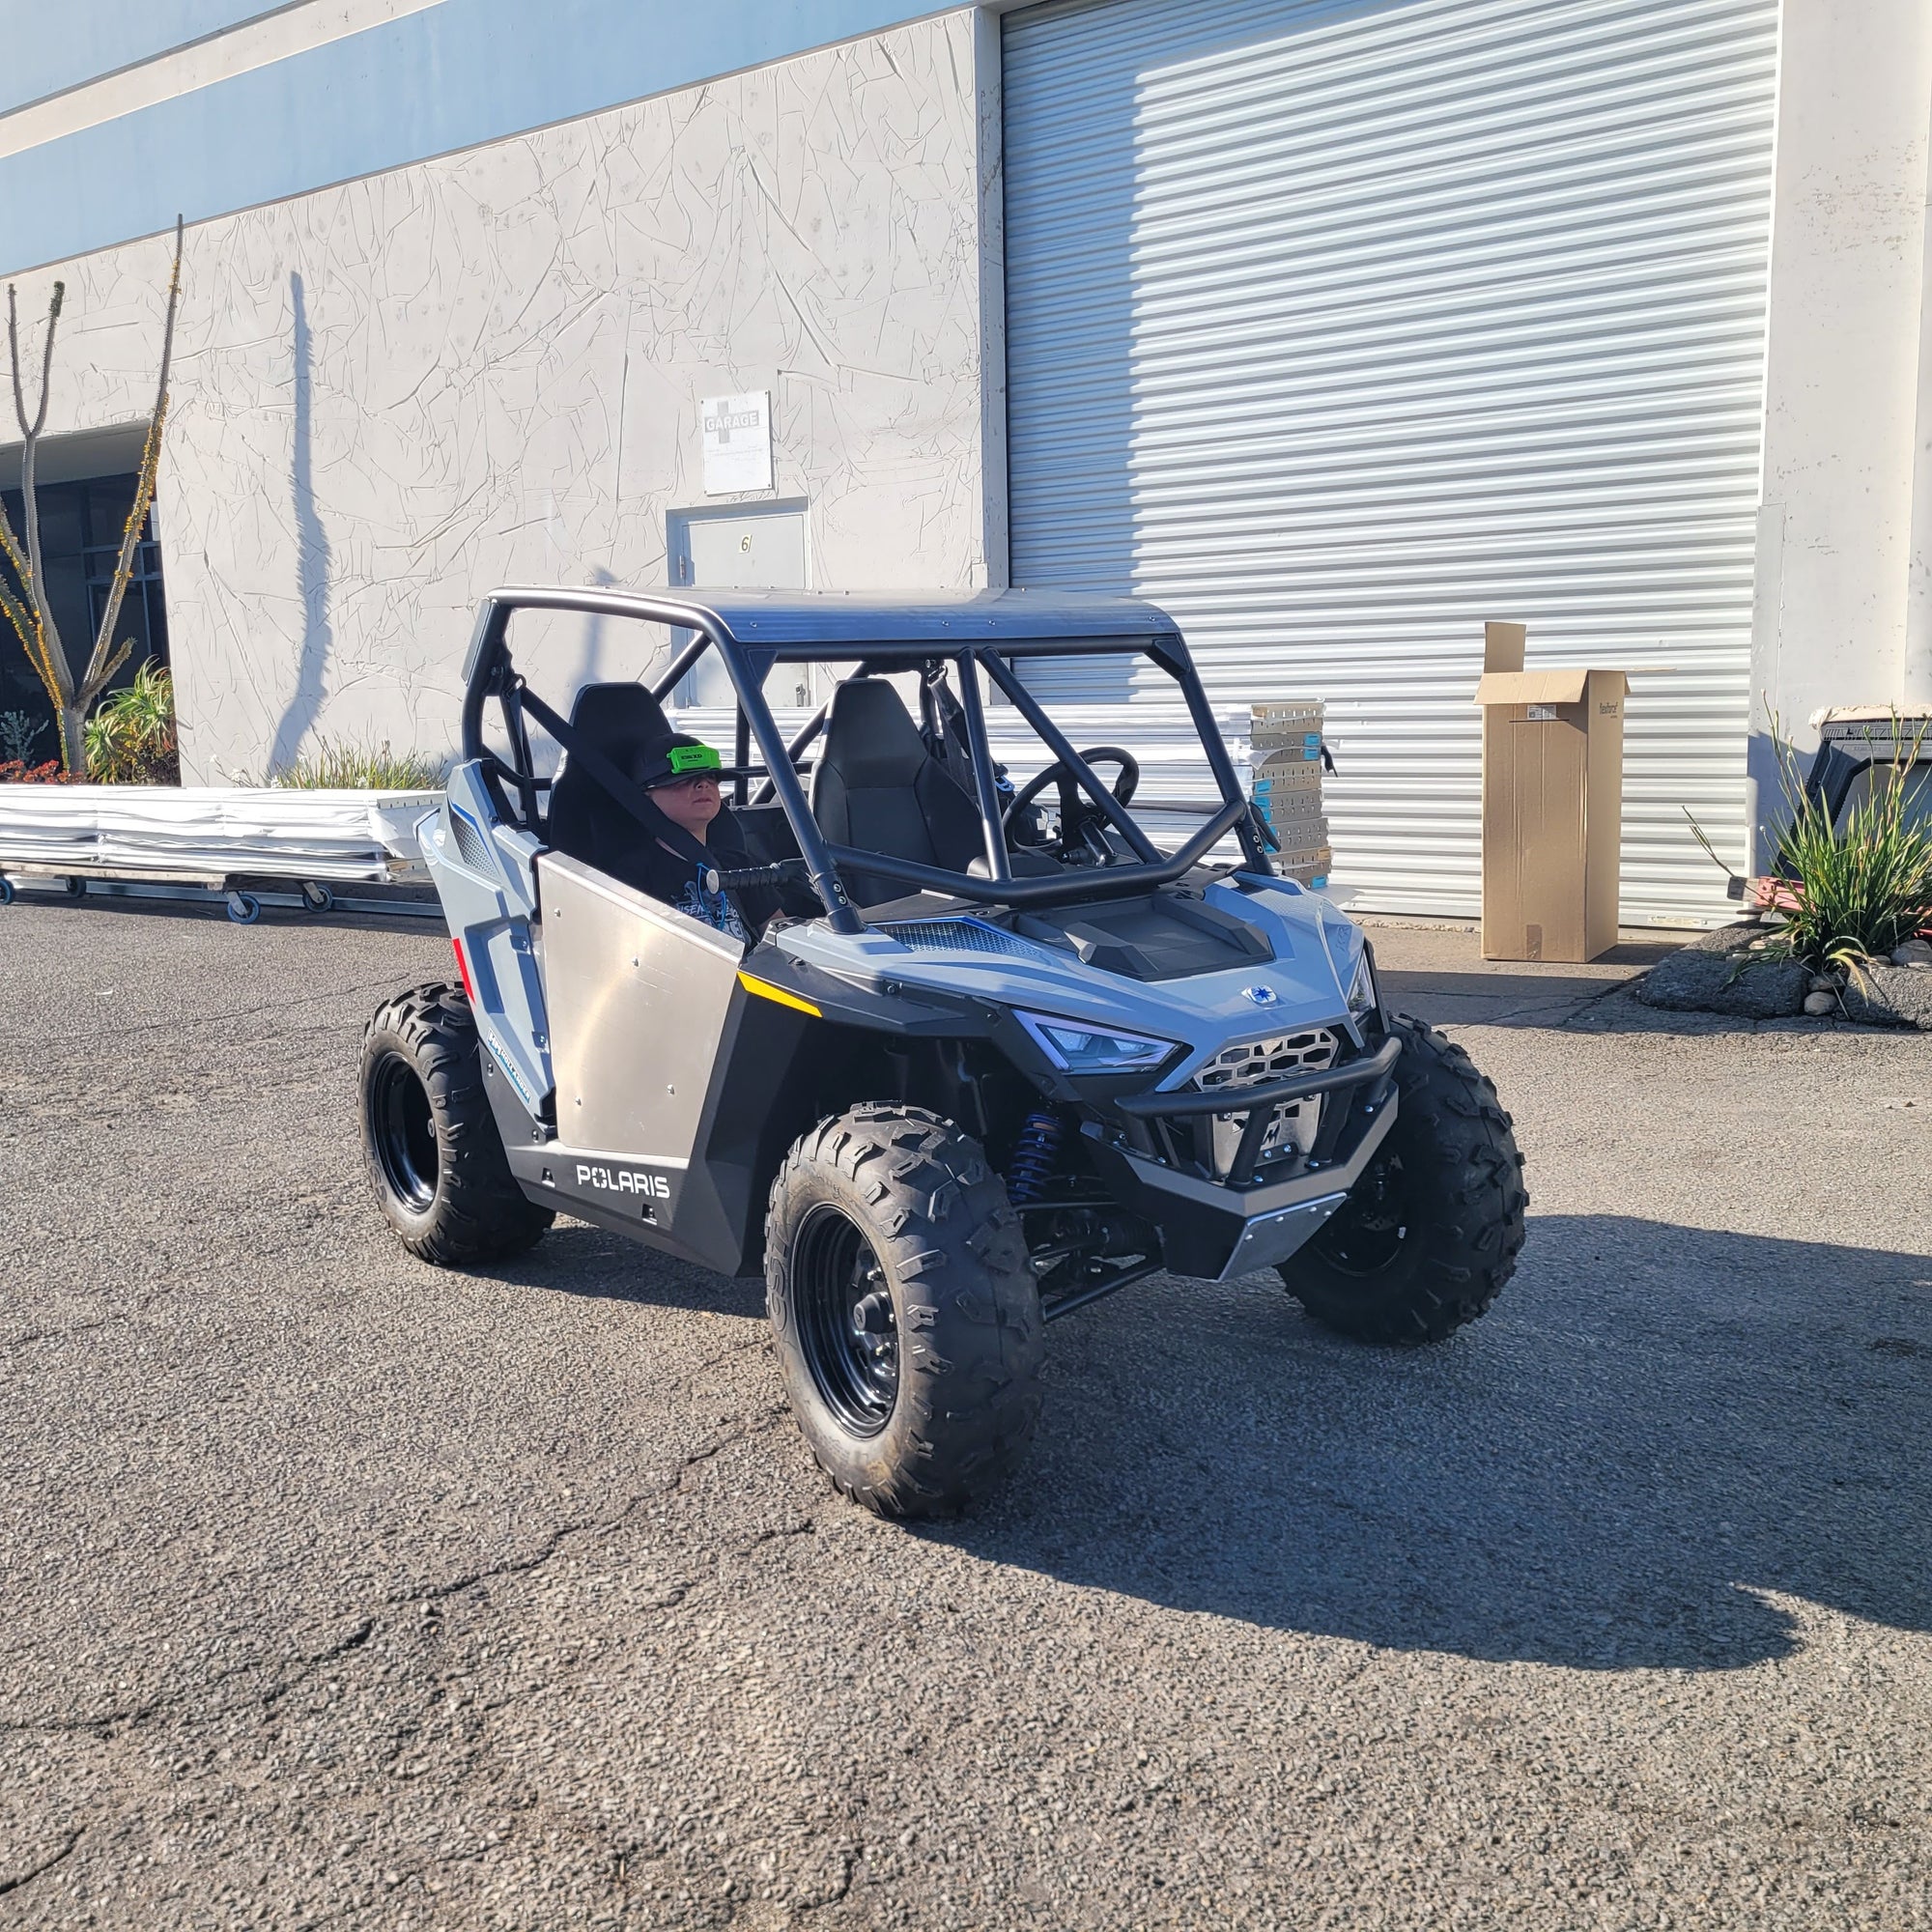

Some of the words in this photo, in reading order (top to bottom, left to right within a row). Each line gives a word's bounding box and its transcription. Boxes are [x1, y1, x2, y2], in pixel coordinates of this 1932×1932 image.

[706, 412, 757, 431] GARAGE
[741, 536, 750, 552] 6
[576, 1164, 670, 1199] POLARIS
